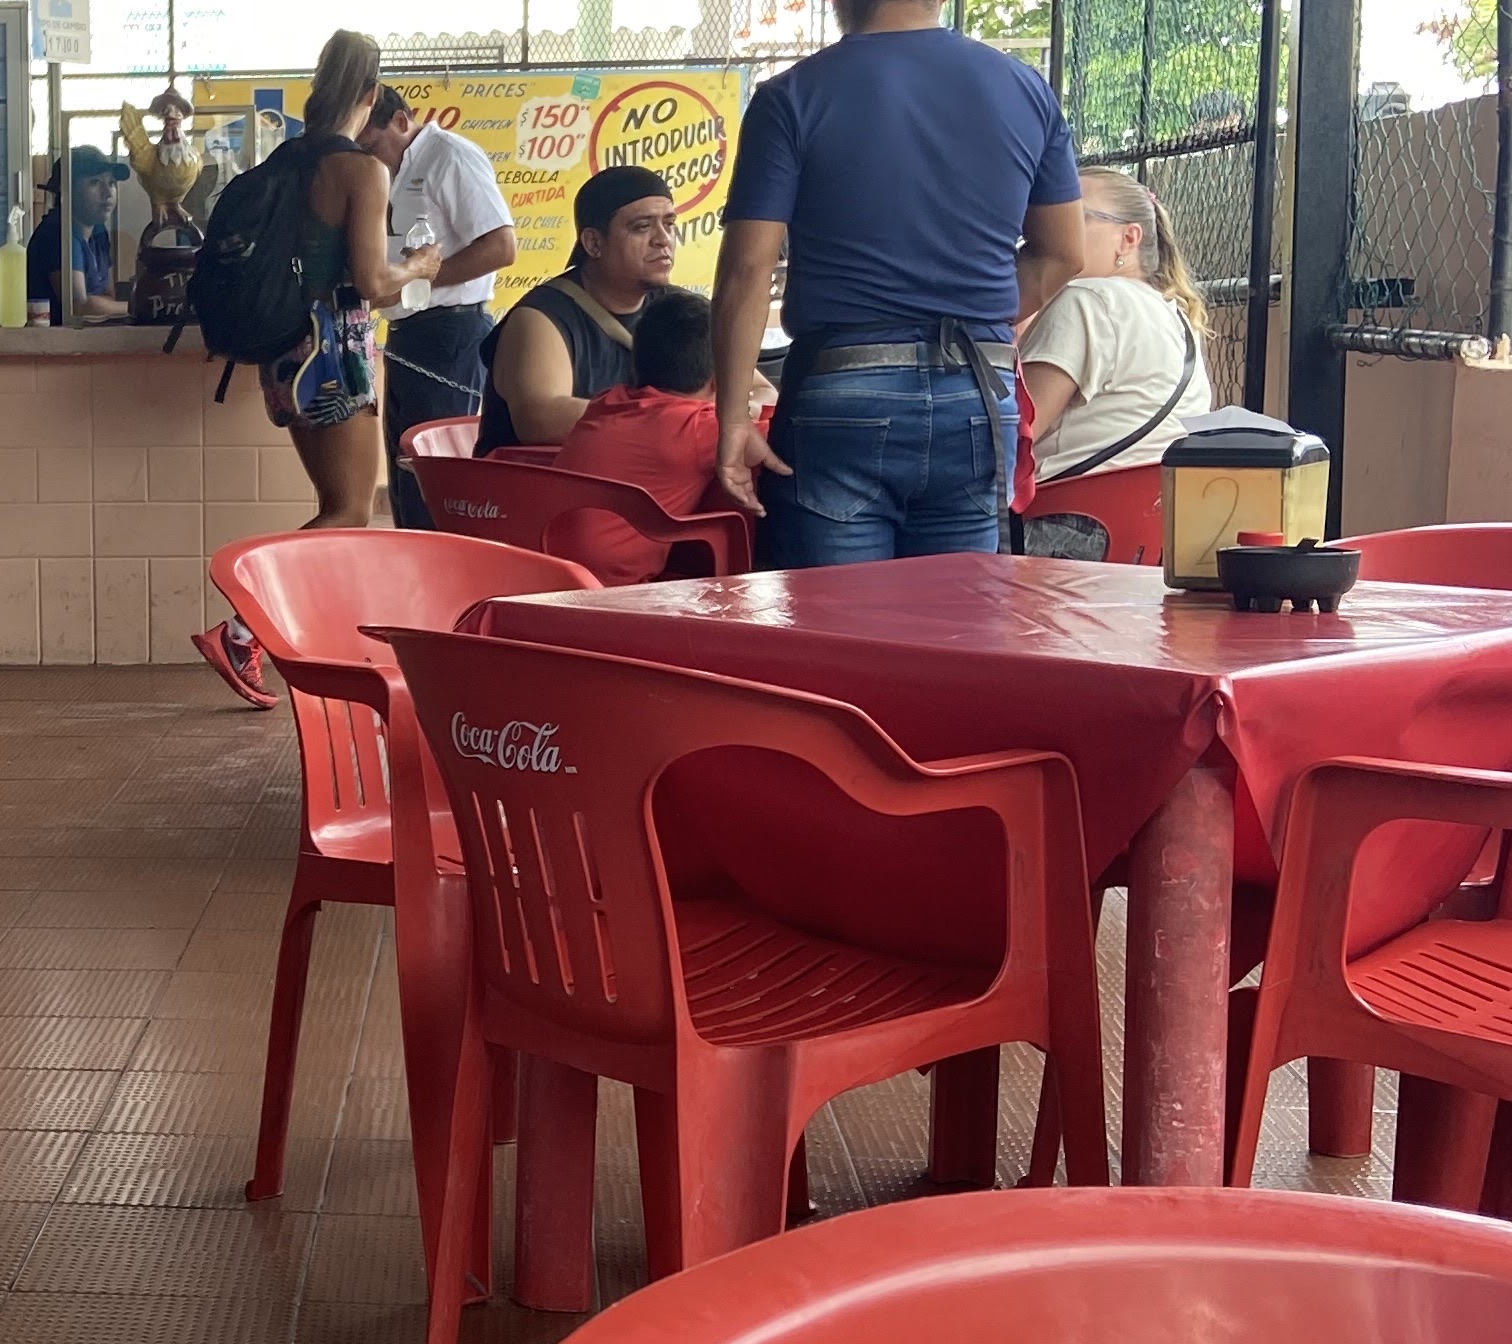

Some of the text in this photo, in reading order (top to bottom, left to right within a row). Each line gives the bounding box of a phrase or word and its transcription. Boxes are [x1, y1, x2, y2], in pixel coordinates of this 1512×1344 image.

[460, 119, 516, 131] CHICKEN
[621, 97, 678, 134] NO
[604, 115, 726, 168] INTRODUCIR
[496, 170, 559, 185] CEBOLLA
[510, 186, 566, 208] CURTIDA
[516, 237, 555, 251] TILLAS
[1194, 476, 1239, 565] 2
[451, 711, 562, 773] Coca-Cola
